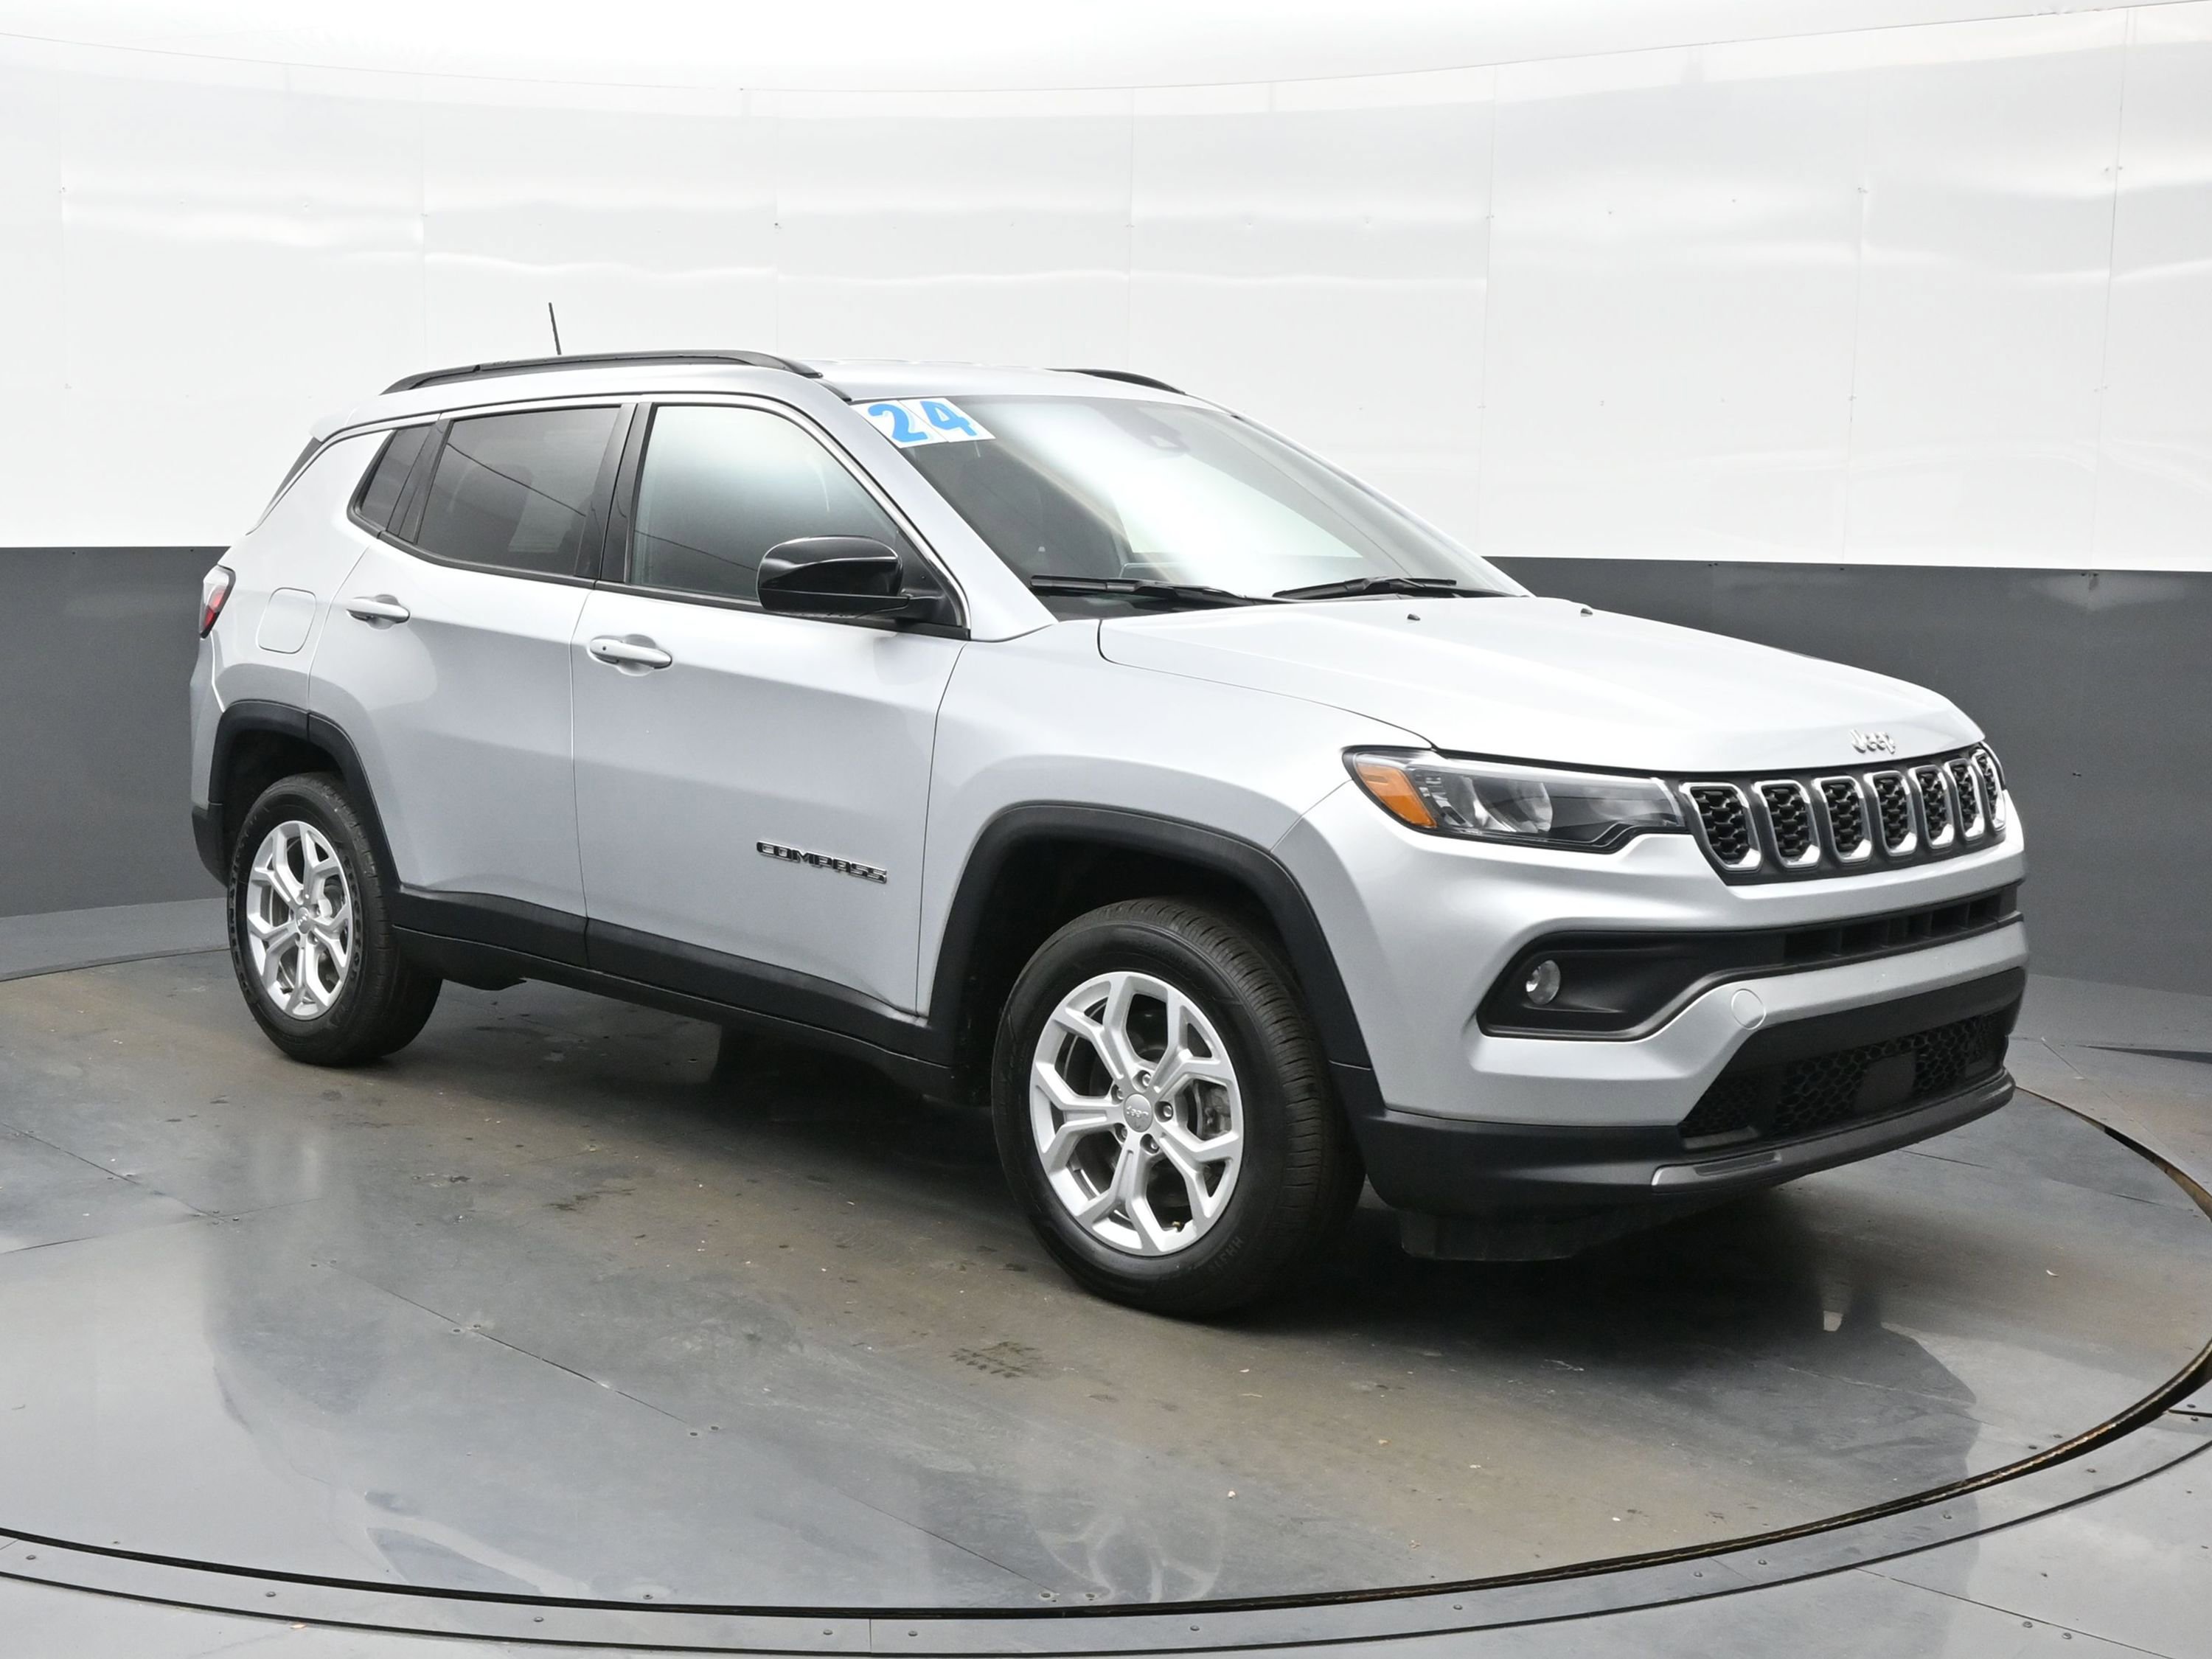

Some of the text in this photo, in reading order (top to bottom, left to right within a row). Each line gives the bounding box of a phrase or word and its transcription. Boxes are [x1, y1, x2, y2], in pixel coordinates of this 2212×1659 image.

[868, 400, 977, 442] 24
[1849, 729, 1896, 755] Jeep
[757, 841, 888, 884] COMPASS
